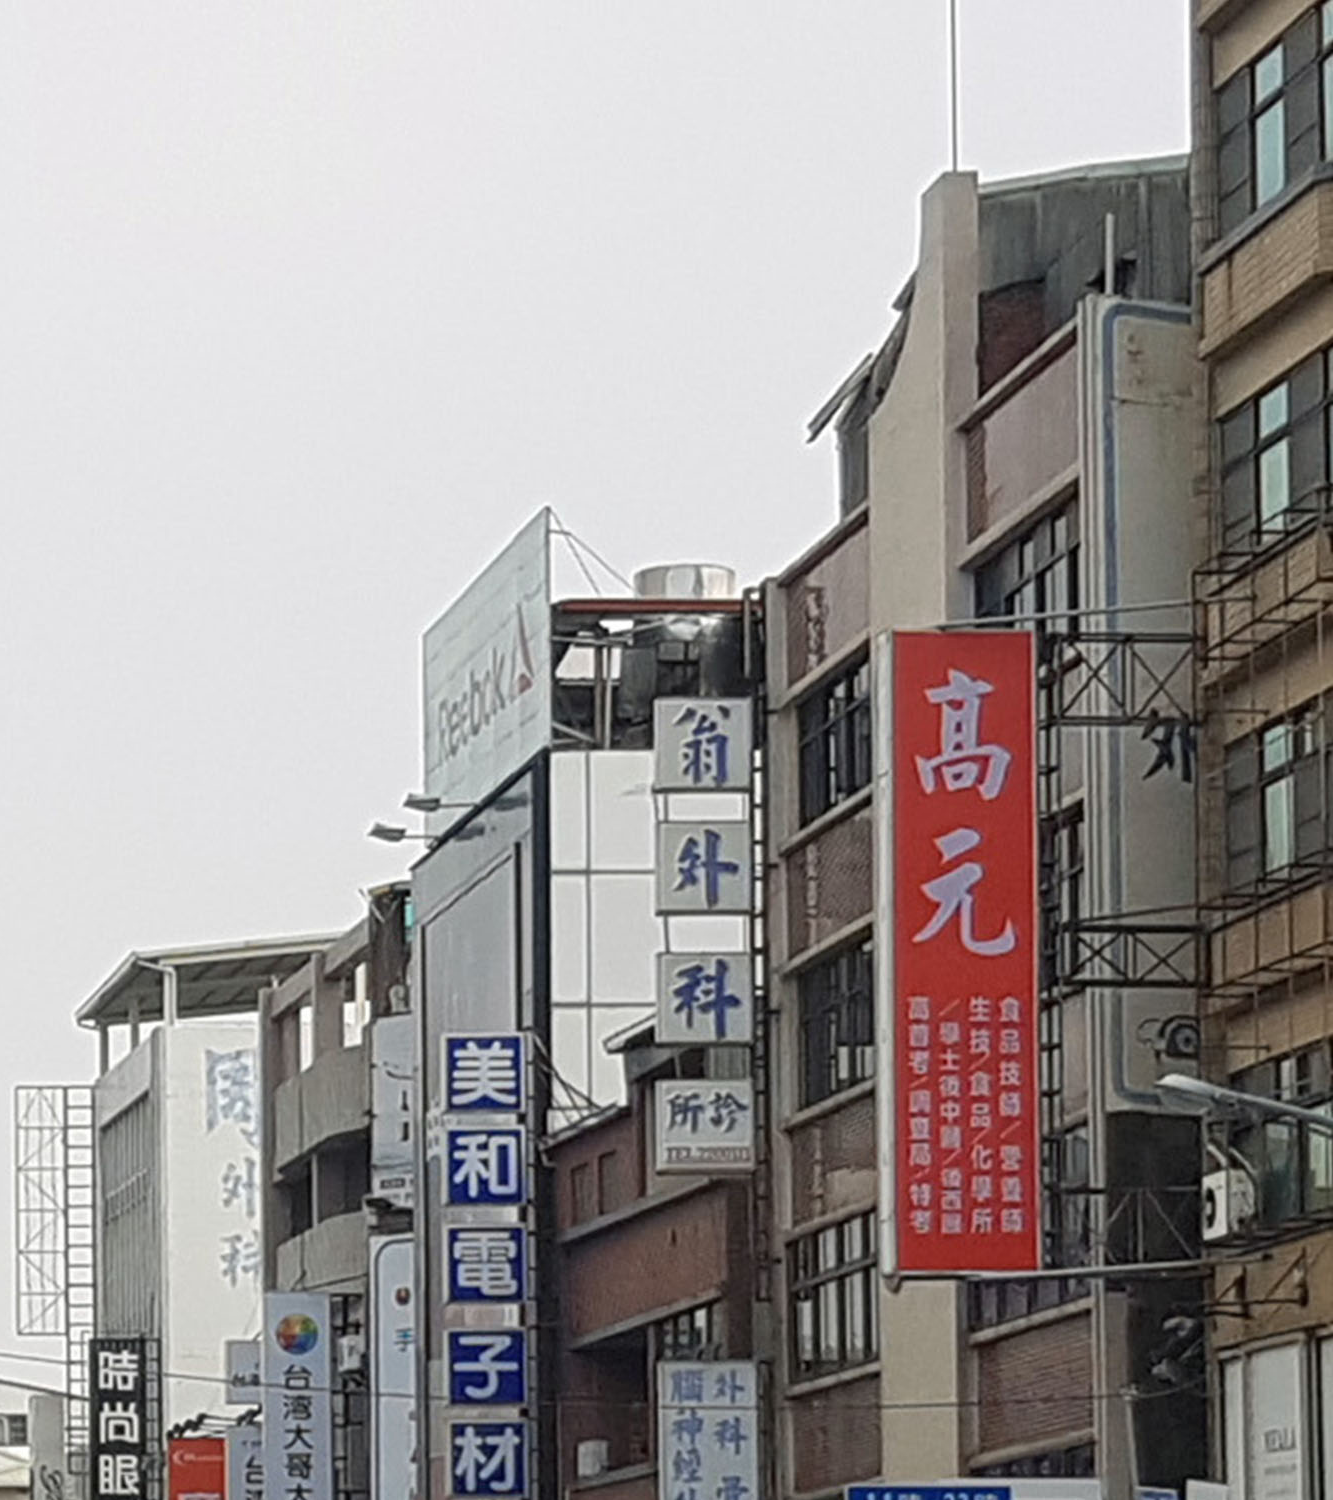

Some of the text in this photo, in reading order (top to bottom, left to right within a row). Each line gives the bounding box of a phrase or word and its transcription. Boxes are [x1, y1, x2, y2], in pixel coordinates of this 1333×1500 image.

[672, 704, 741, 1040] 翁外科
[913, 668, 1016, 956] 高元
